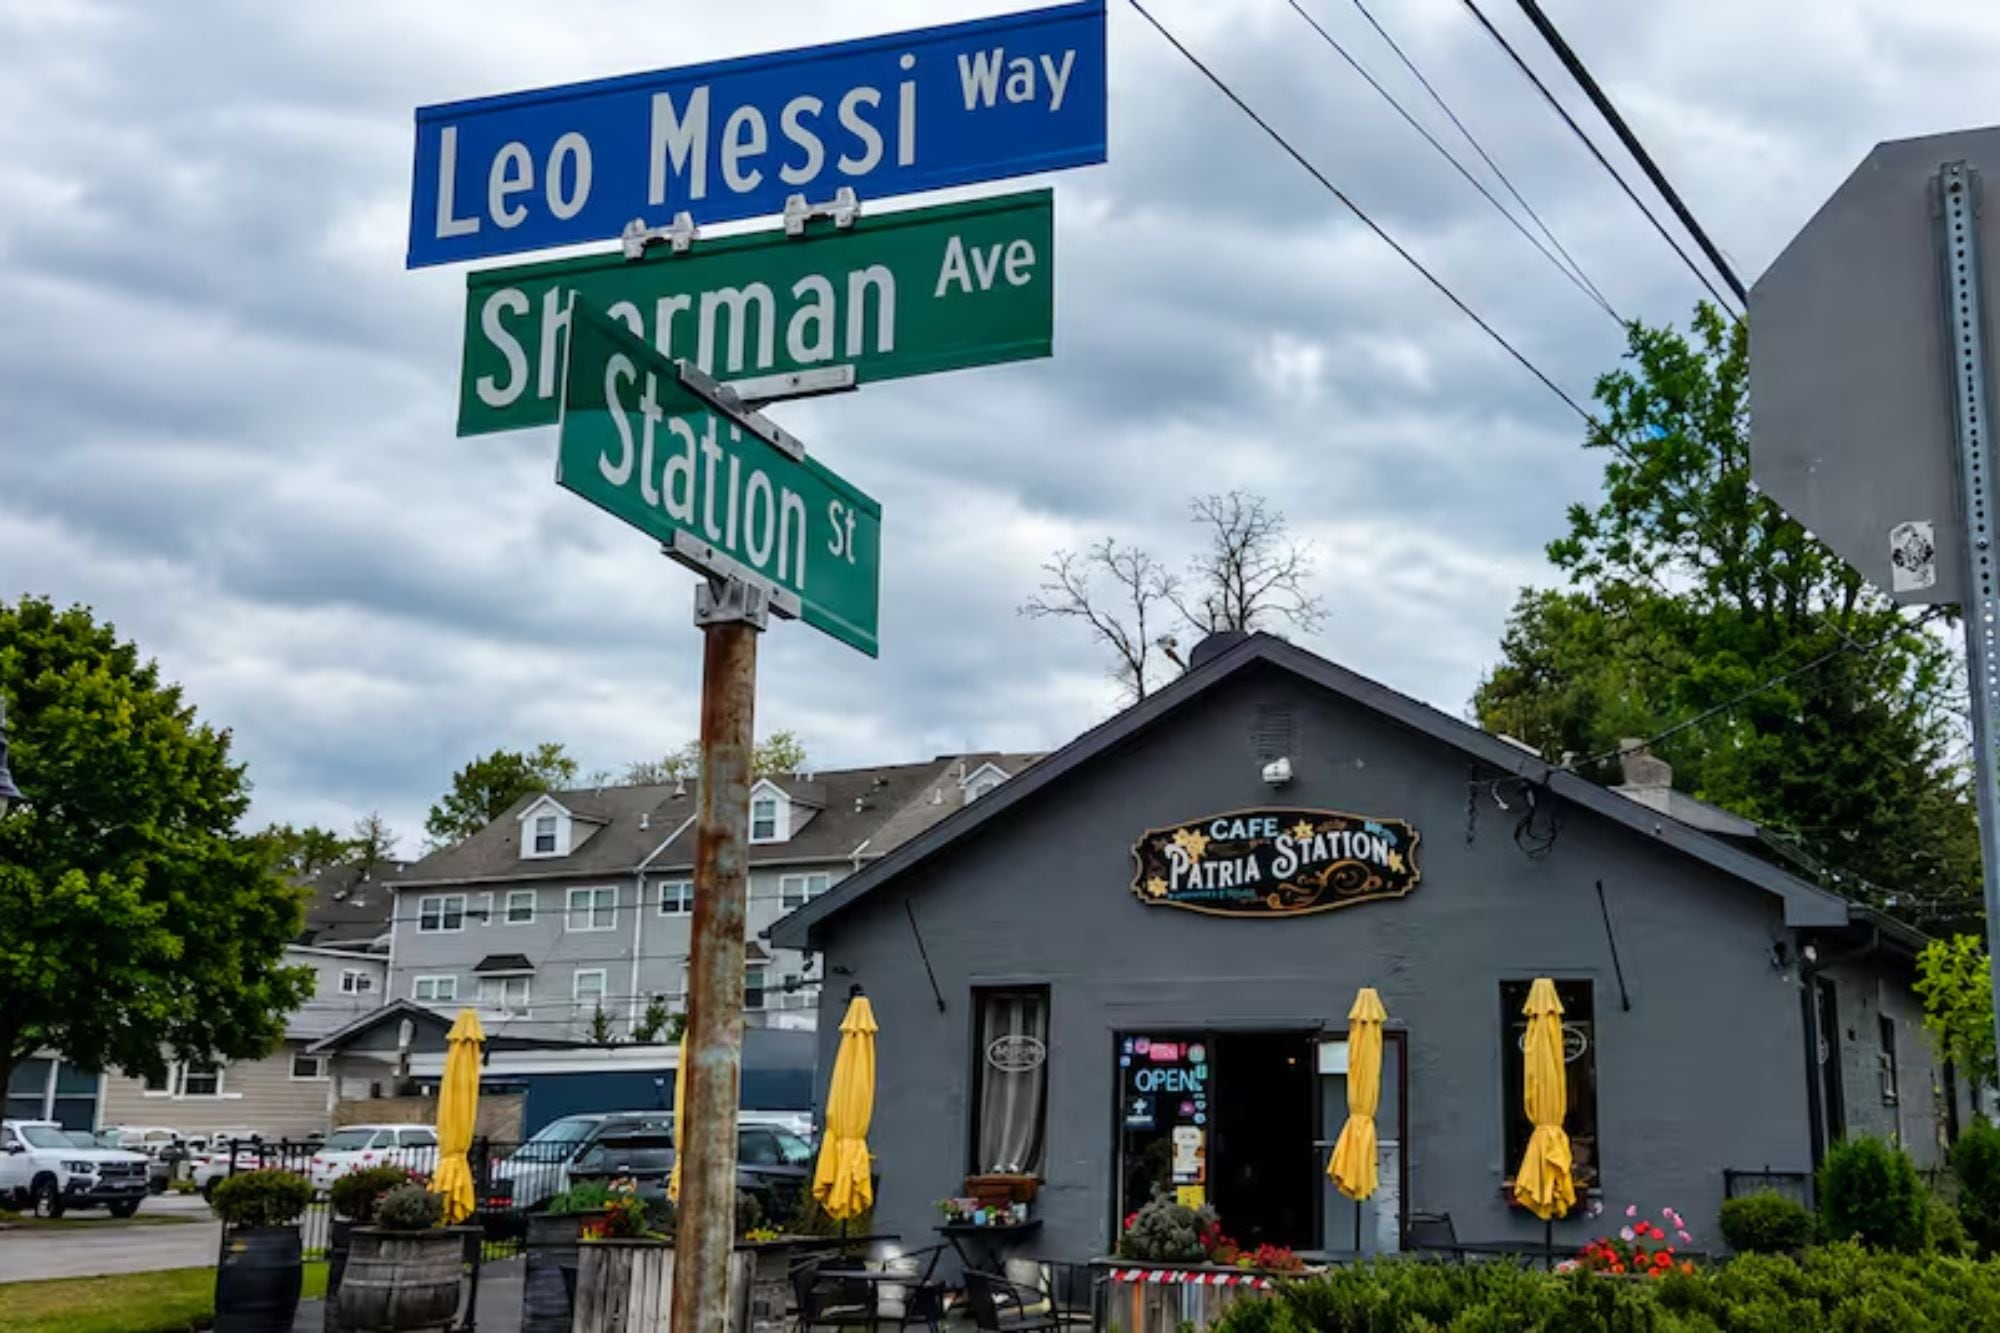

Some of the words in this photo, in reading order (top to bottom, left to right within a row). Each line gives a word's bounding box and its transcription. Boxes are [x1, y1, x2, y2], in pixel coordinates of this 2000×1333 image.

[435, 126, 593, 239] Leo
[648, 55, 917, 205] Messi
[957, 48, 1077, 112] Way
[934, 236, 1037, 297] Ave
[599, 353, 807, 590] Station
[827, 500, 857, 566] St
[1209, 817, 1280, 841] CAFE
[1164, 843, 1261, 890] PATRIA
[1271, 831, 1389, 879] STATION
[1135, 1068, 1197, 1092] OPEN
